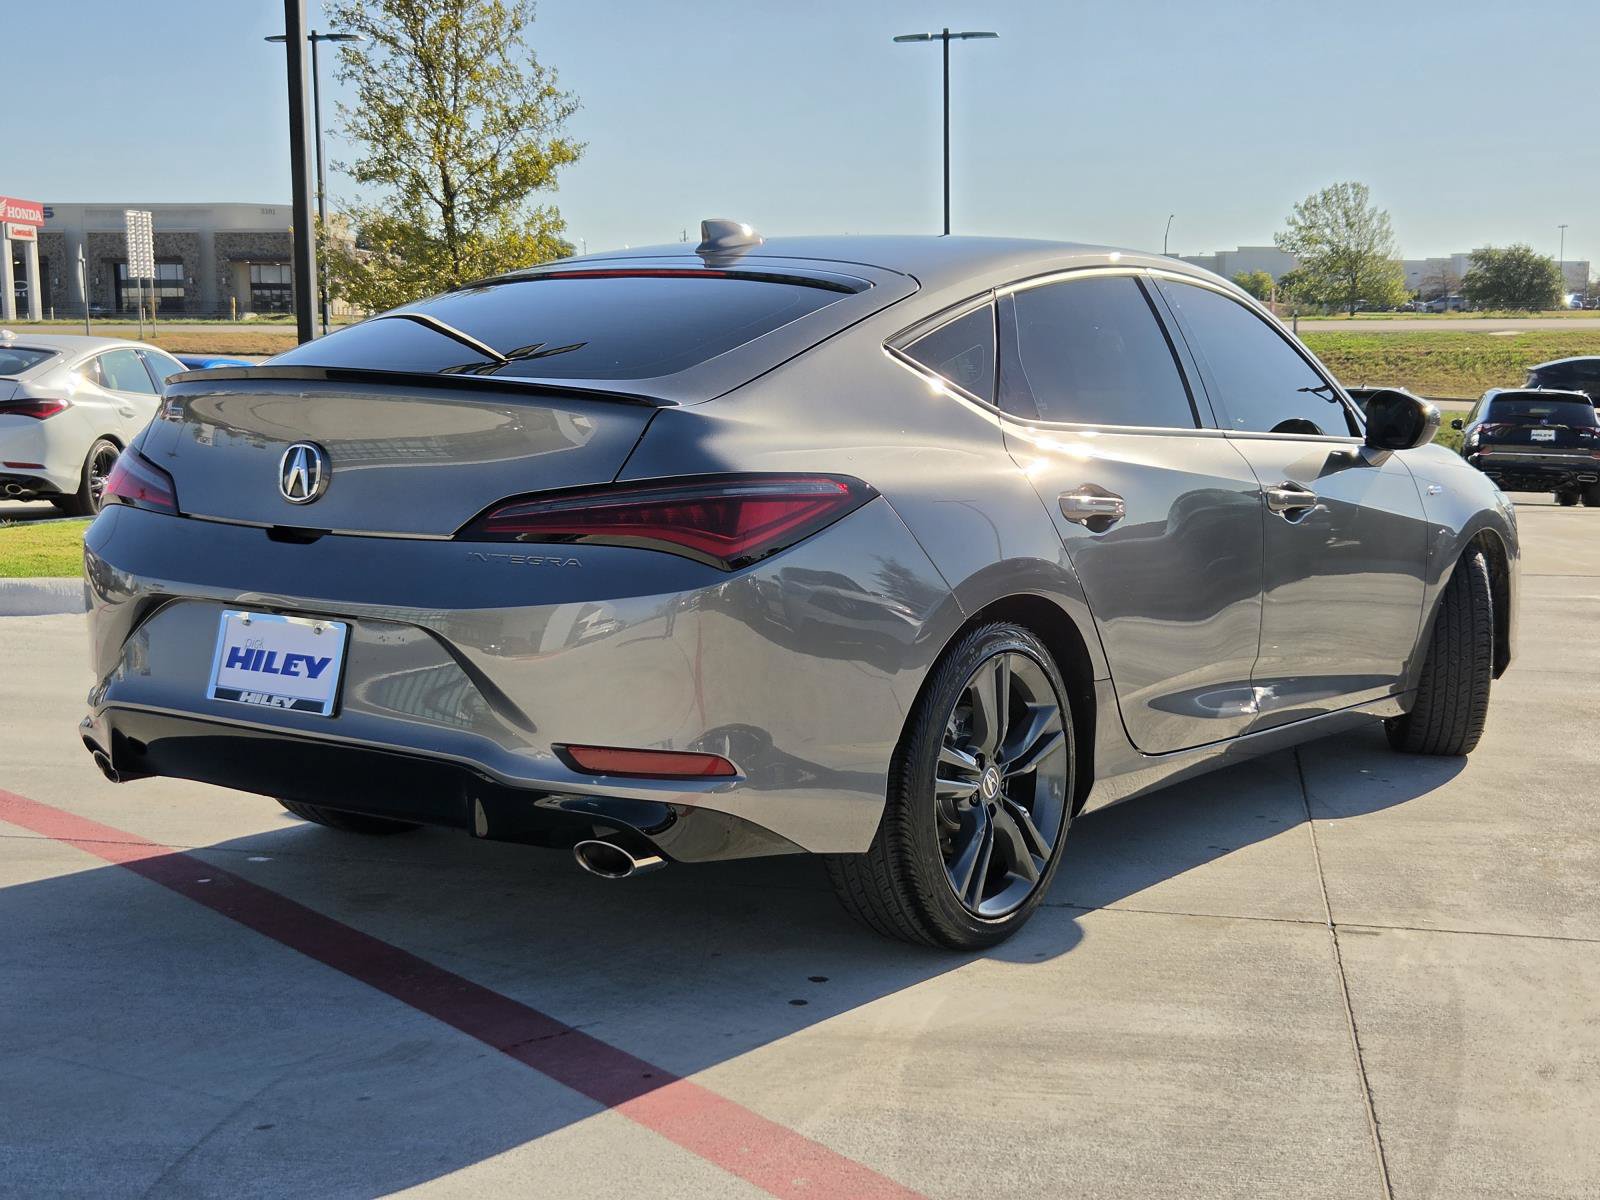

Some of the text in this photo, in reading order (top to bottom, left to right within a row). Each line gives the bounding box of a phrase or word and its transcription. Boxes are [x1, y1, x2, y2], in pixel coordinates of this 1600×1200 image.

[7, 205, 43, 222] HONDA
[467, 552, 582, 568] INTEGRA
[225, 646, 332, 679] HILEY
[239, 691, 297, 709] HILEY
